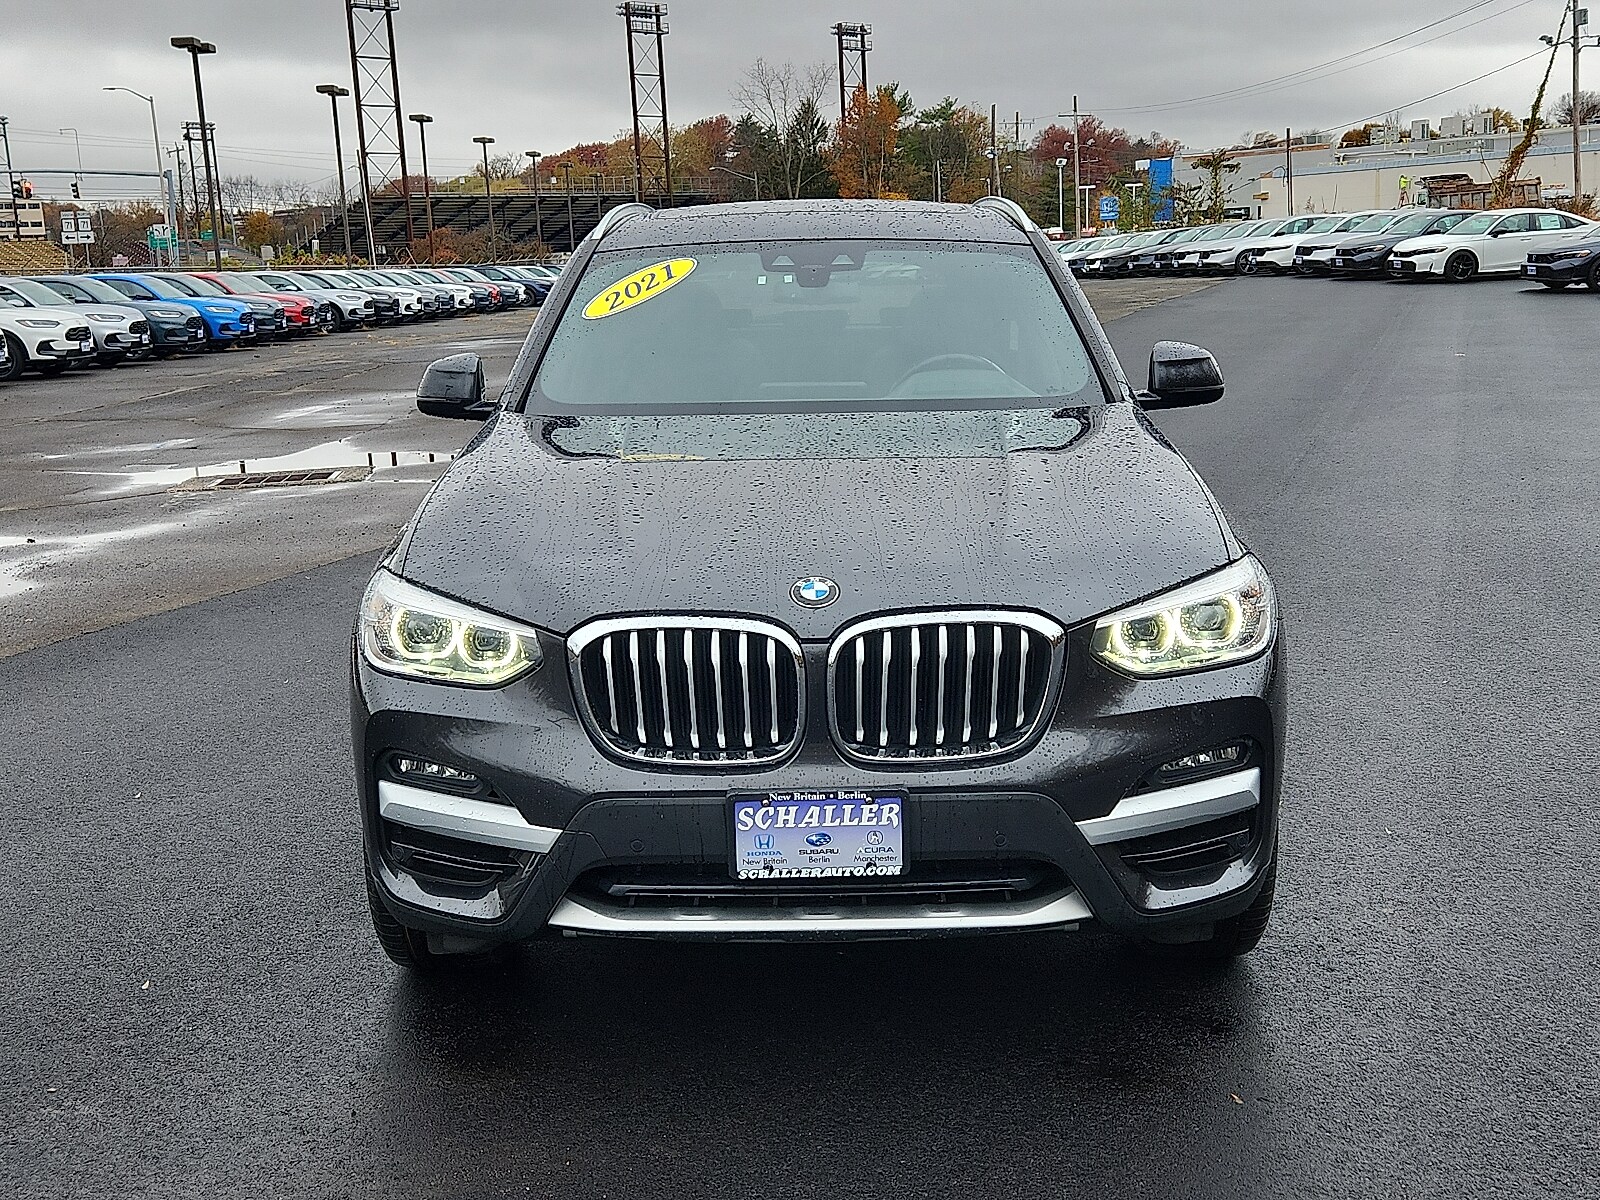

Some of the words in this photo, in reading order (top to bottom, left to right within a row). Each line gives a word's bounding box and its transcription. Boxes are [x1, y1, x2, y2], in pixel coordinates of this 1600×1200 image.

[64, 221, 73, 230] 71
[80, 220, 89, 229] 71
[605, 264, 677, 311] 2021
[769, 793, 792, 802] New
[793, 792, 826, 801] Britain
[837, 791, 867, 800] Berlin
[737, 803, 900, 831] SCHALLER
[798, 848, 840, 856] SUBARU
[856, 846, 895, 854] ACURA
[763, 857, 788, 865] Britain
[808, 856, 831, 864] Berlin
[853, 855, 898, 863] Manchester
[738, 865, 902, 880] SCHALLERAUTO.COM
